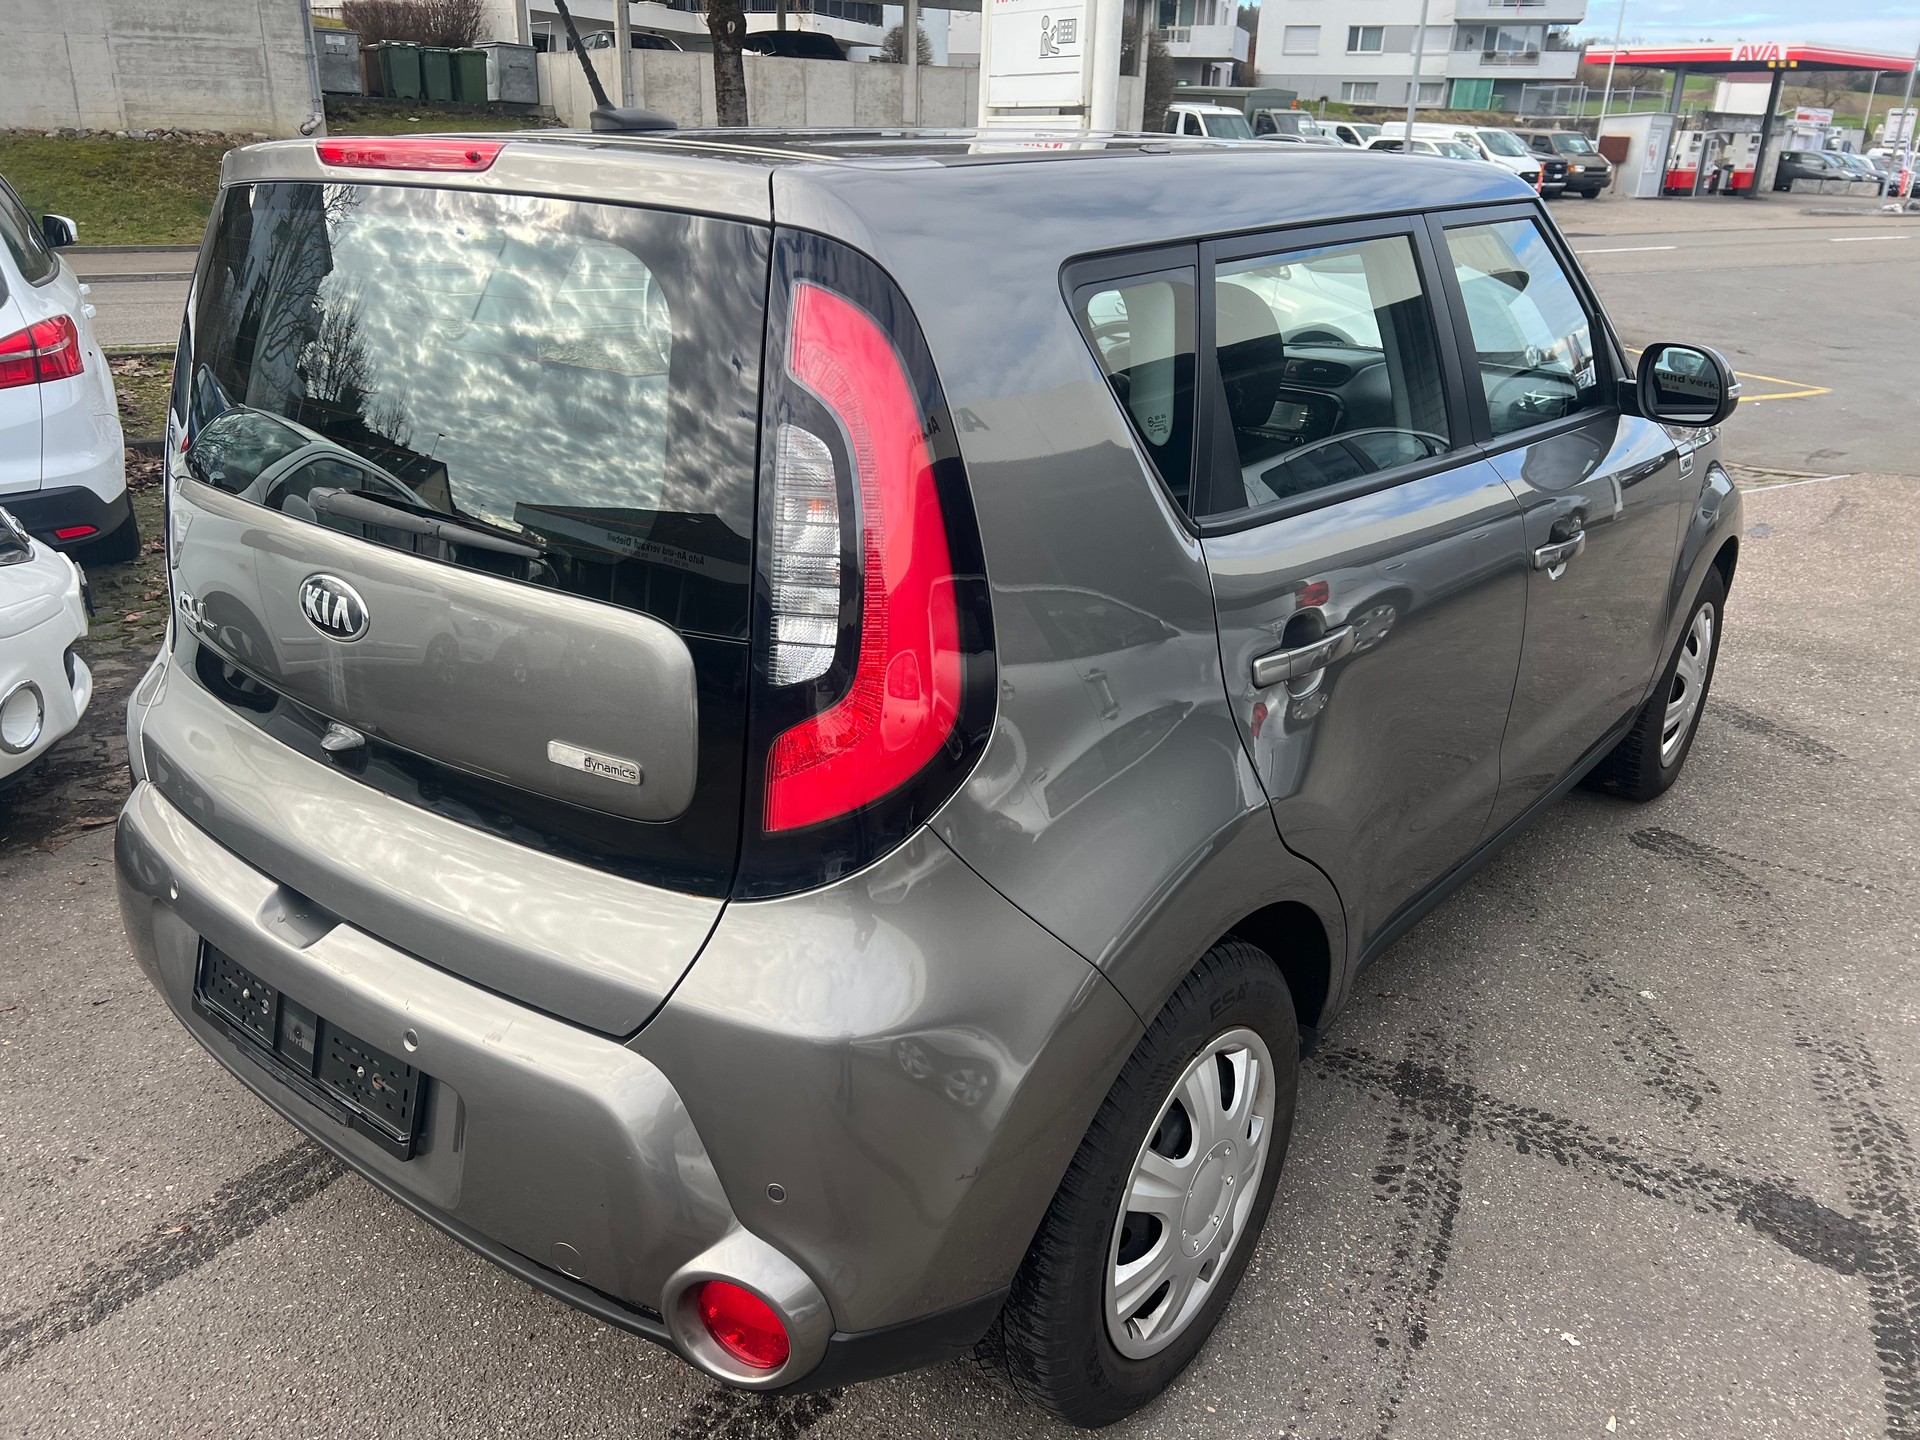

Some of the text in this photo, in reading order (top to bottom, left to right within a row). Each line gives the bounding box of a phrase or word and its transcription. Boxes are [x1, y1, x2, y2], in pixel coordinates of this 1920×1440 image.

[1737, 43, 1779, 60] AVIA
[305, 584, 354, 633] KIA
[584, 757, 637, 780] dynamics
